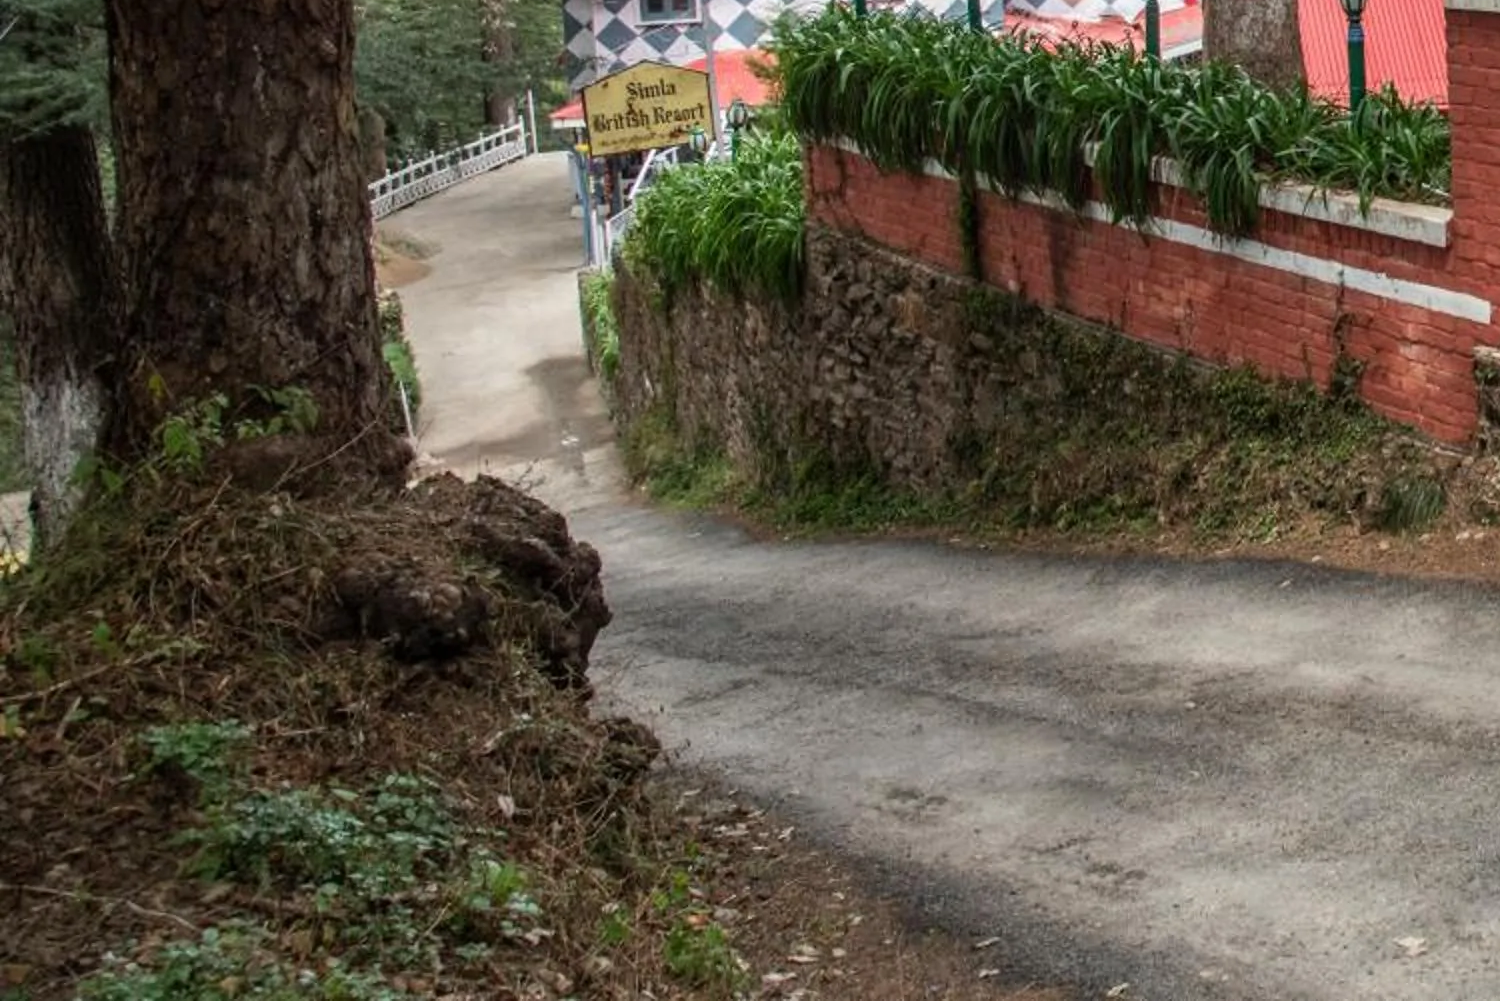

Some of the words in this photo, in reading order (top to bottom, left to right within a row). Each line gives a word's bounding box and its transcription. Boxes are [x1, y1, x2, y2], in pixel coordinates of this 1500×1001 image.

[626, 79, 677, 99] Simla
[593, 108, 650, 132] British
[652, 103, 705, 125] Resort
